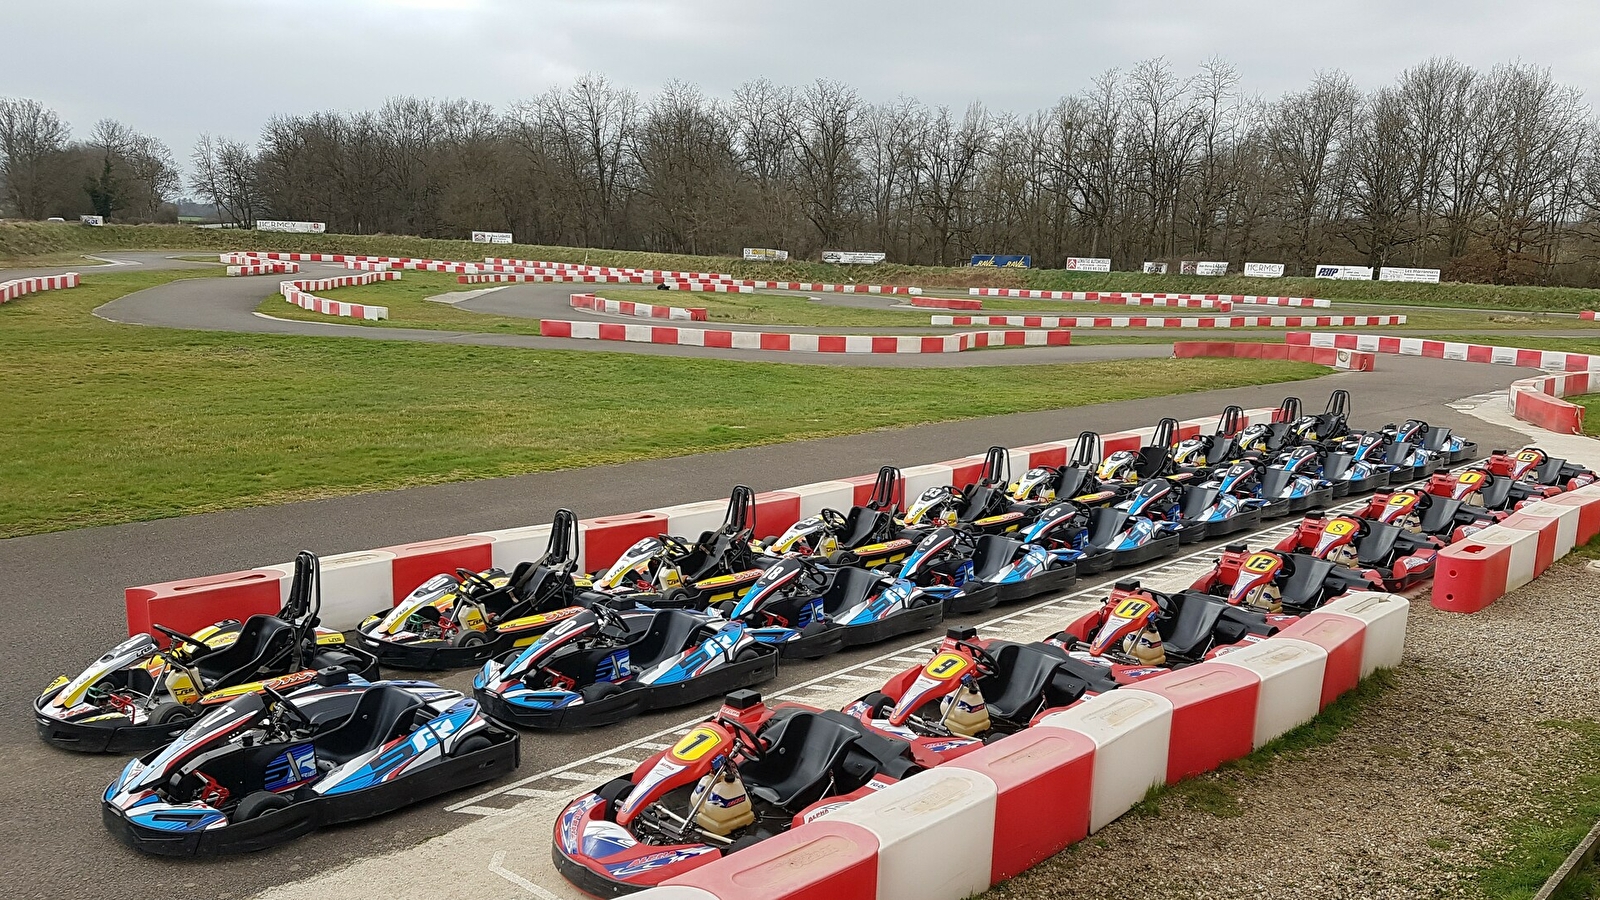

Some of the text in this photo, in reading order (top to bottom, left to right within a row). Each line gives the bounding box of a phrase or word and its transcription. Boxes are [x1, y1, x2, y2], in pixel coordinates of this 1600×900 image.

[1231, 466, 1245, 474] 15
[1247, 556, 1273, 570] 12
[1119, 601, 1146, 617] 14
[932, 658, 958, 674] 9
